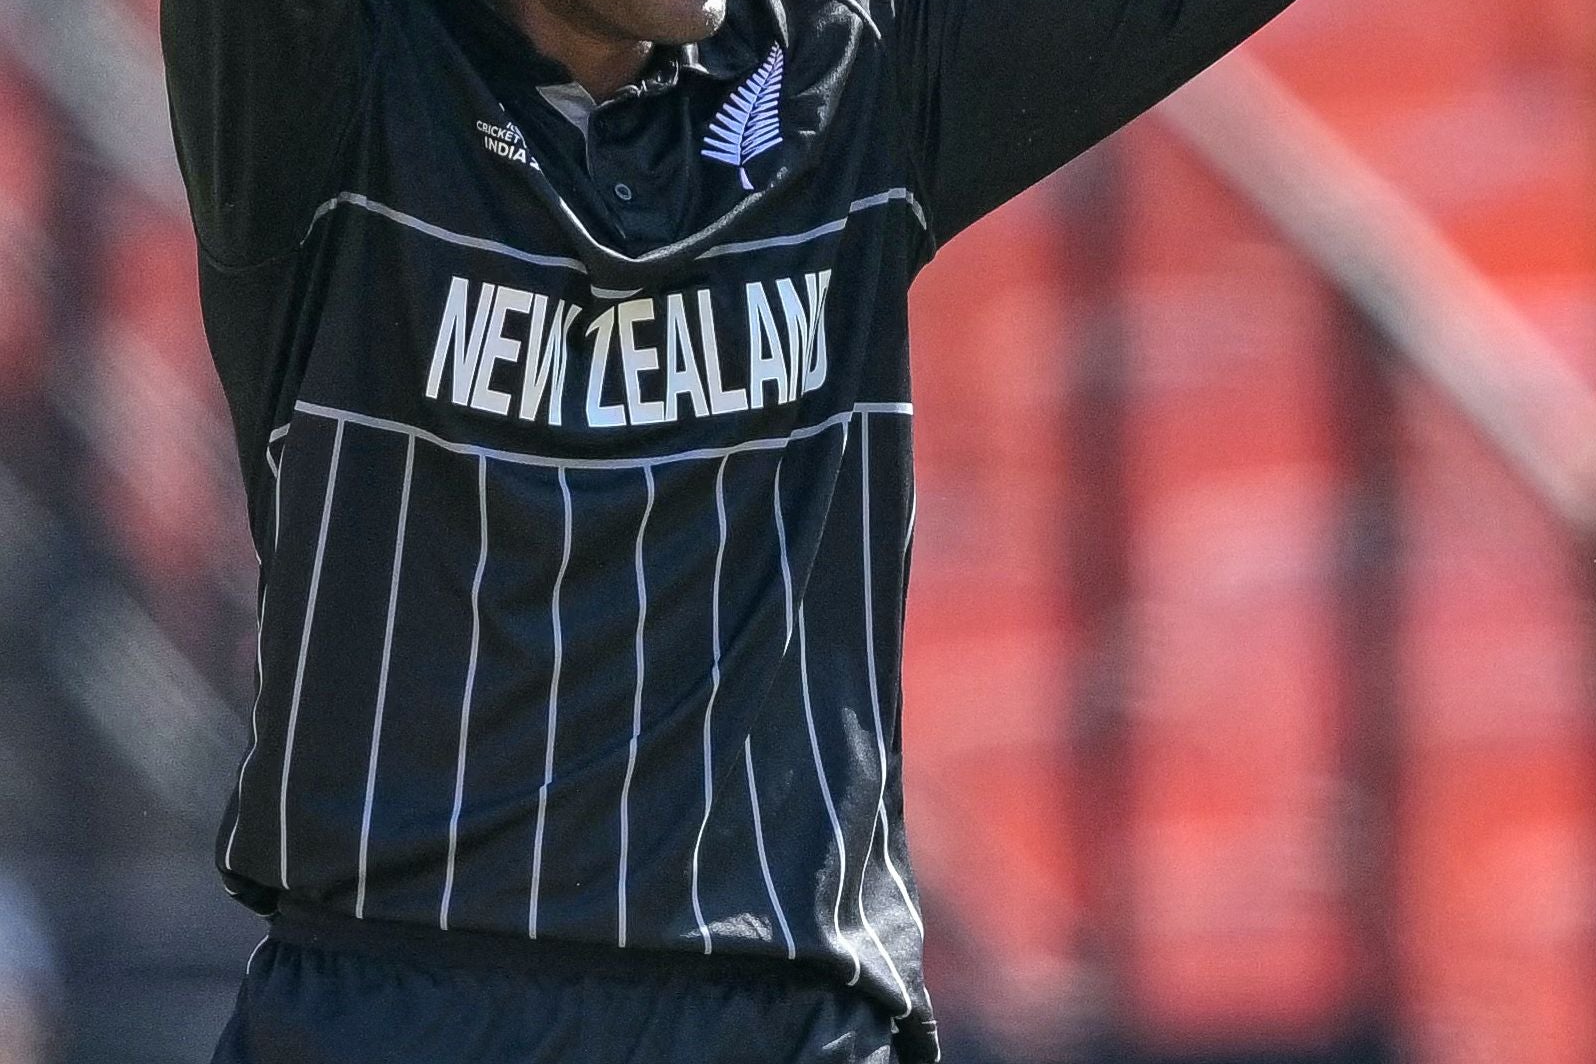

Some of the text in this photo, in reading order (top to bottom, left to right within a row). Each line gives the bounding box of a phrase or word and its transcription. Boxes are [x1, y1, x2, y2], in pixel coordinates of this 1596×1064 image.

[476, 120, 520, 144] CRICKET
[484, 136, 526, 164] INDIA
[425, 269, 832, 428] NEW ZEALAND
